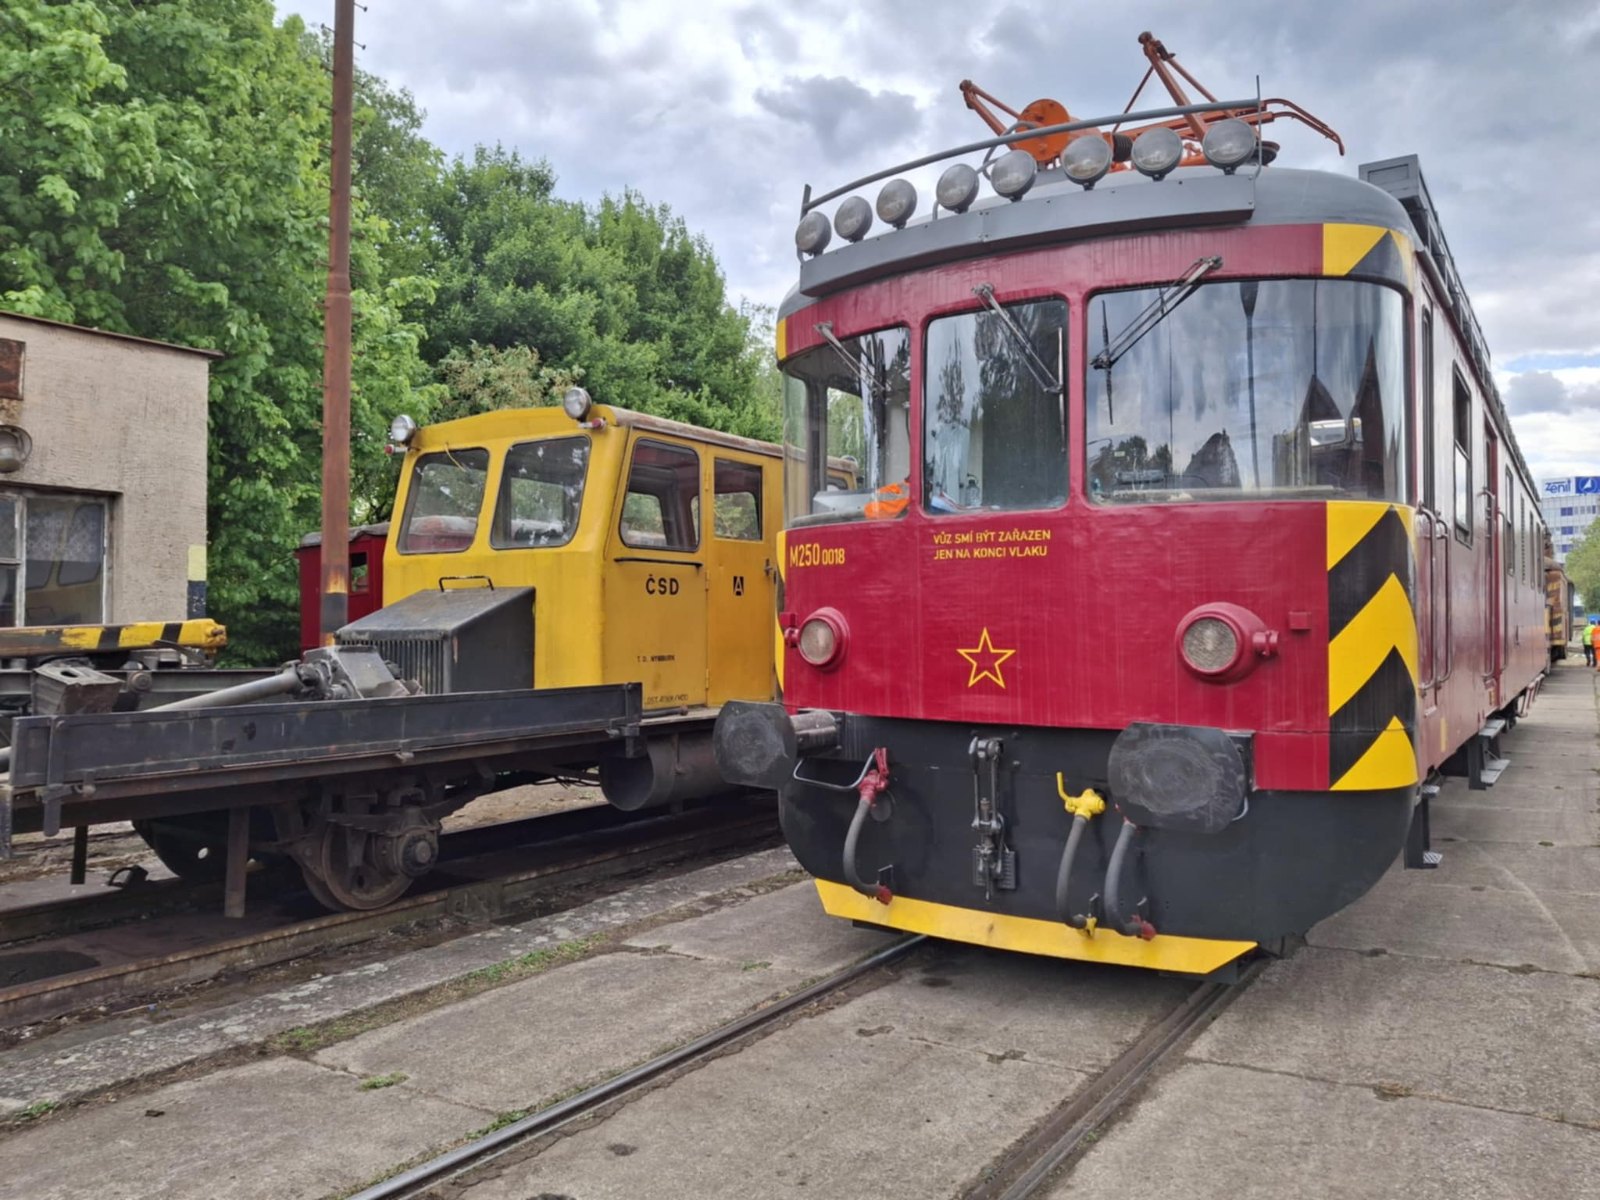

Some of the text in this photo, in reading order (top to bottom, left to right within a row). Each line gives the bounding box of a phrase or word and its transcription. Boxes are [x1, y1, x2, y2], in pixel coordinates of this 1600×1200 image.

[933, 528, 1051, 544] VŮZ SMÍ BÝT ZAŘAZEN
[789, 543, 845, 568] M250 0018
[934, 546, 1047, 560] JEN NA KONCI VLAKU
[645, 574, 680, 596] ČSD
